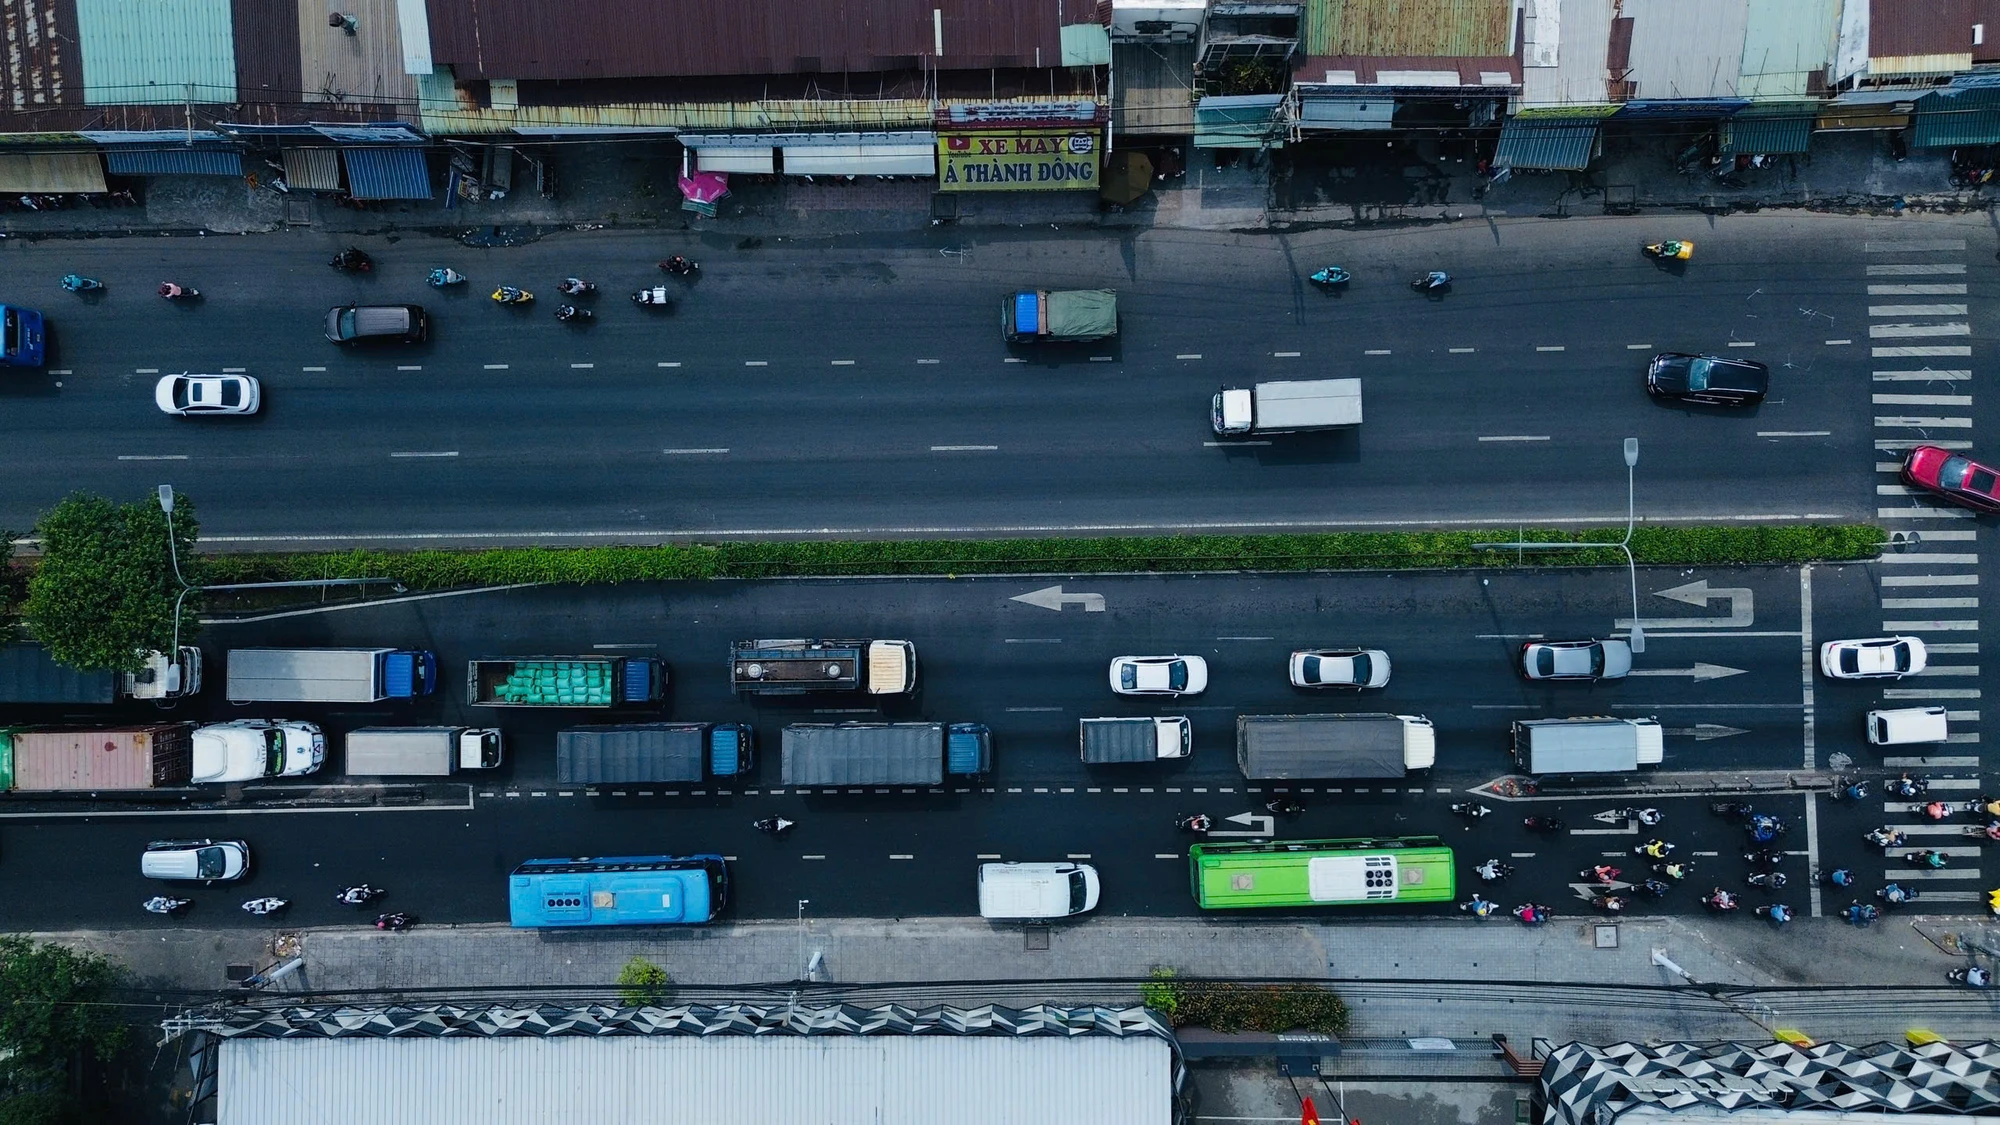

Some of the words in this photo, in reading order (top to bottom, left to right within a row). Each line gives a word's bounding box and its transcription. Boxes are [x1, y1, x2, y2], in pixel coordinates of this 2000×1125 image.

[947, 150, 971, 158] YouTube
[978, 139, 1008, 155] XE
[943, 159, 959, 183] Á
[963, 158, 1032, 183] THÀNH
[1037, 157, 1093, 182] ĐÔNG
